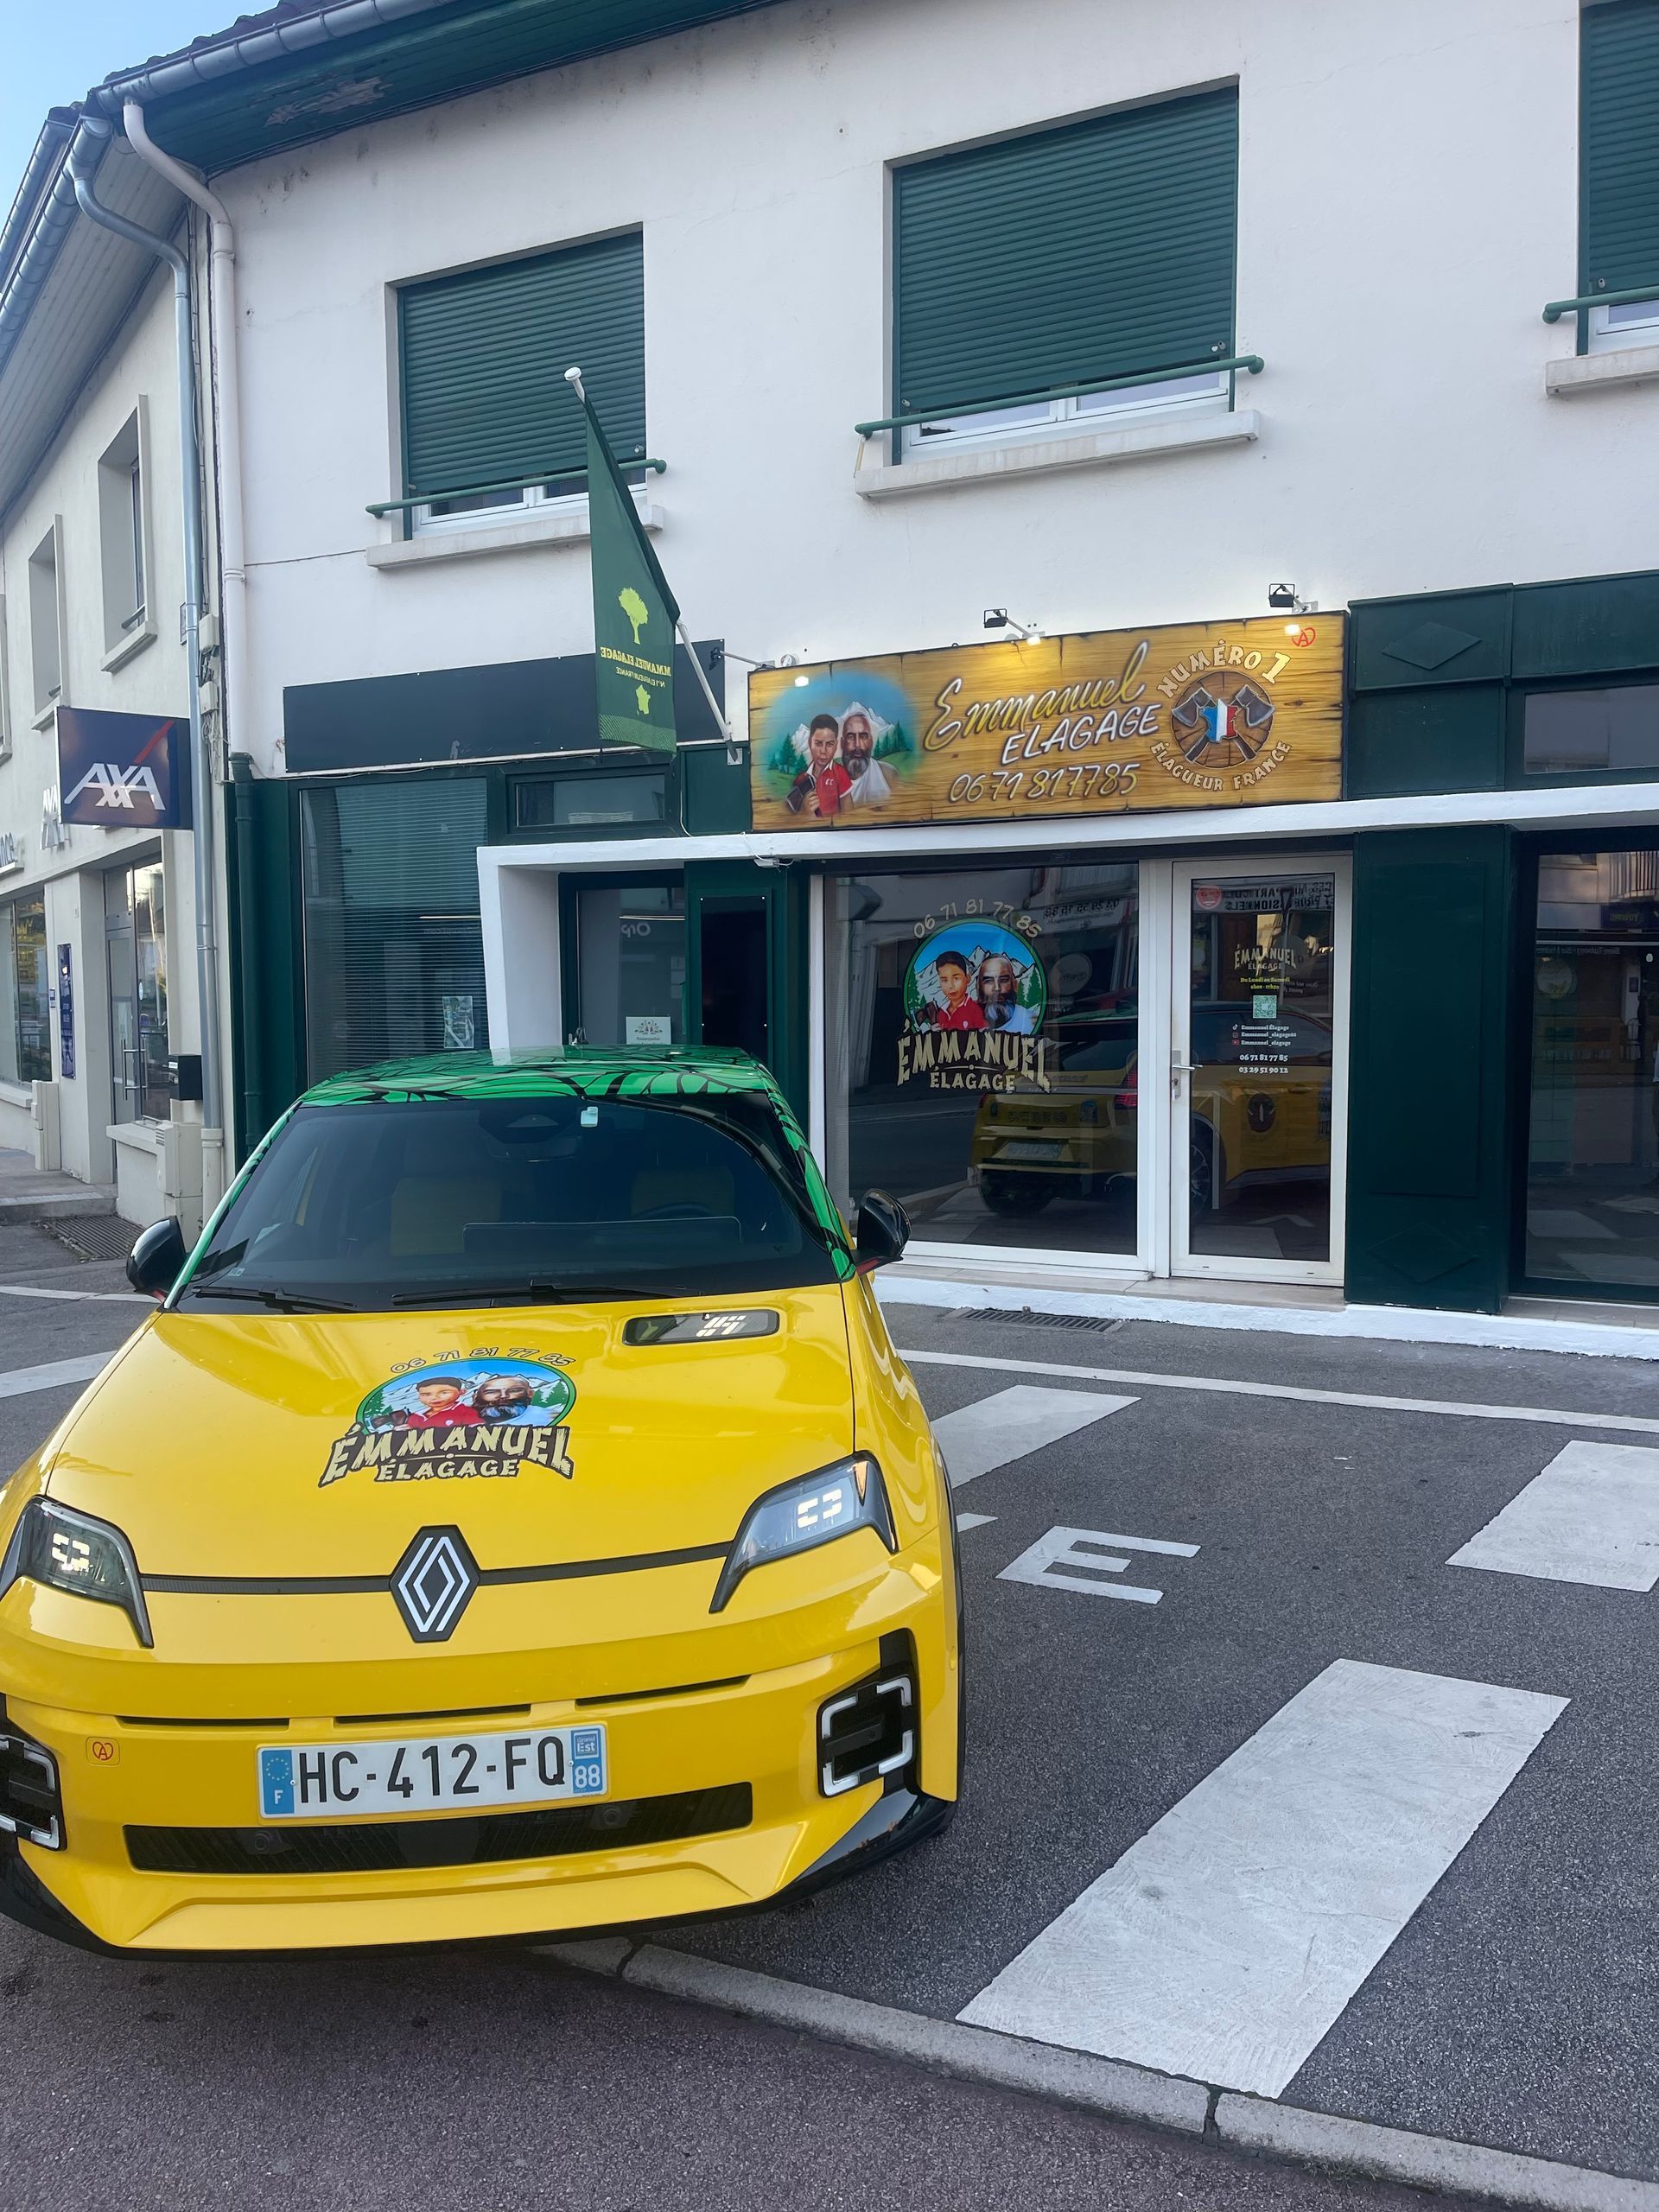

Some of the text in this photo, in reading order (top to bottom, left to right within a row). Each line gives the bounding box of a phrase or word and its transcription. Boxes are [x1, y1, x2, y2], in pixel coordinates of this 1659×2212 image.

[1156, 639, 1291, 698] NUMÉRO 1
[924, 641, 1148, 751] Emmanuel
[1001, 704, 1162, 766] ELAGAGE
[1150, 740, 1293, 791] ÉLAGUEUR FRANCE
[64, 762, 166, 810] AXA
[913, 914, 936, 939] 06
[940, 902, 958, 920] 71
[965, 899, 984, 914] 81
[994, 901, 1015, 919] 77
[1016, 915, 1043, 938] 85
[1234, 944, 1297, 969] ÉMMANUEL
[1248, 961, 1284, 970] ÉLAGAGE
[897, 1018, 1051, 1094] ÉMMANUEL
[930, 1066, 1016, 1094] ÉLAGAGE
[391, 1347, 576, 1374] 06 71 81 77 85
[319, 1423, 573, 1487] ÉMMANUEL
[376, 1458, 520, 1482] ÉLAGAGE
[576, 1741, 596, 1752] Est
[298, 1735, 566, 1803] HC-412-FQ
[575, 1764, 601, 1789] 88
[273, 1789, 283, 1805] F
